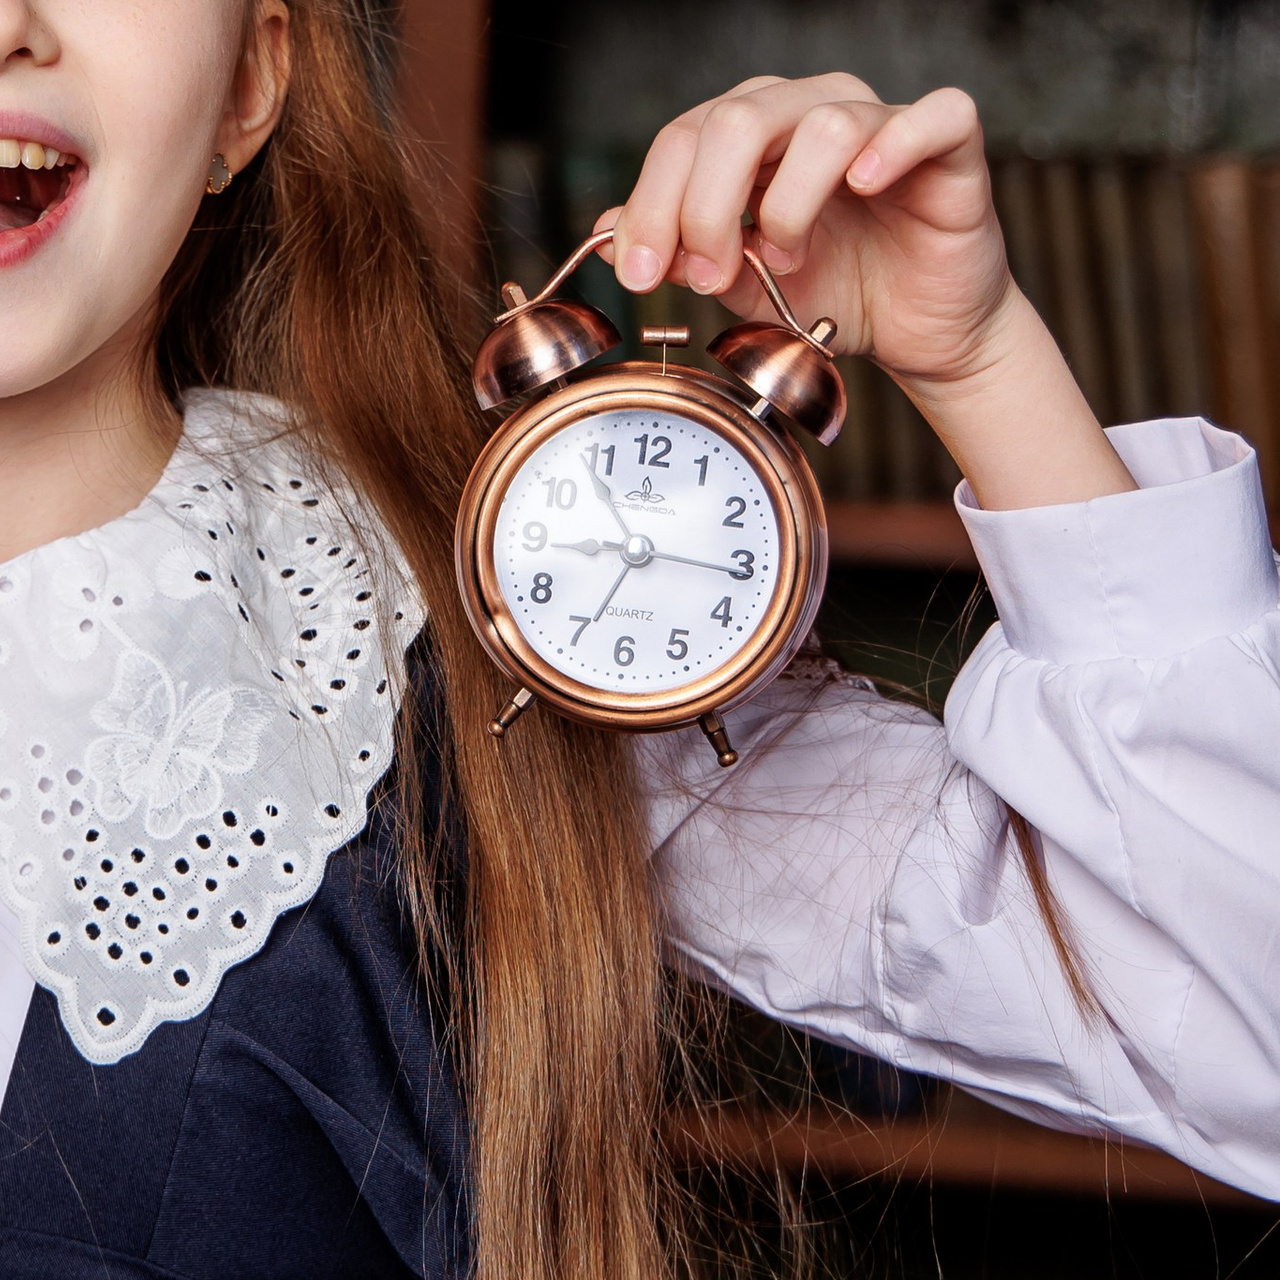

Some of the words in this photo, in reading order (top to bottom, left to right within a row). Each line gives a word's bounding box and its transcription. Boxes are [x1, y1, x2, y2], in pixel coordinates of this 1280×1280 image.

[584, 442, 616, 476] 11
[634, 433, 672, 468] 12
[693, 454, 709, 486] 1
[541, 476, 578, 510] 10
[612, 501, 676, 516] CHENGDA
[722, 496, 747, 529] 2
[521, 521, 548, 552] 9
[728, 549, 755, 581] 3
[530, 572, 553, 604] 8
[605, 605, 654, 621] QUARTZ
[710, 596, 733, 628] 4
[569, 615, 592, 647] 7
[665, 628, 690, 660] 5
[613, 635, 636, 667] 6
